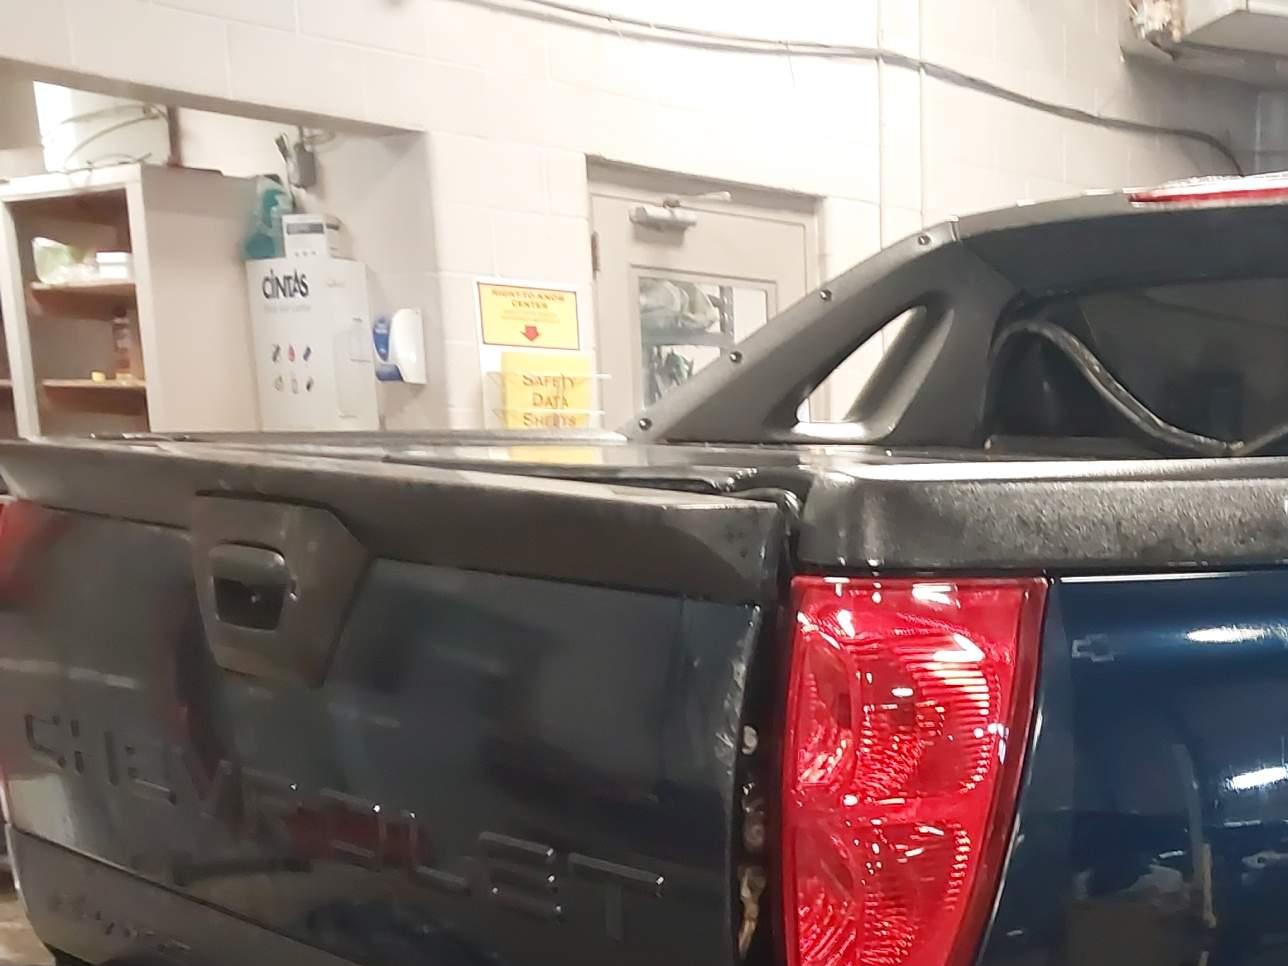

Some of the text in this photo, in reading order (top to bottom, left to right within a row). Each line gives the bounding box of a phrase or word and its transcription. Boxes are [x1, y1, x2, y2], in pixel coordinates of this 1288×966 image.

[262, 268, 309, 299] CINTAS
[522, 374, 575, 390] SAFETY
[532, 391, 569, 408] DATA
